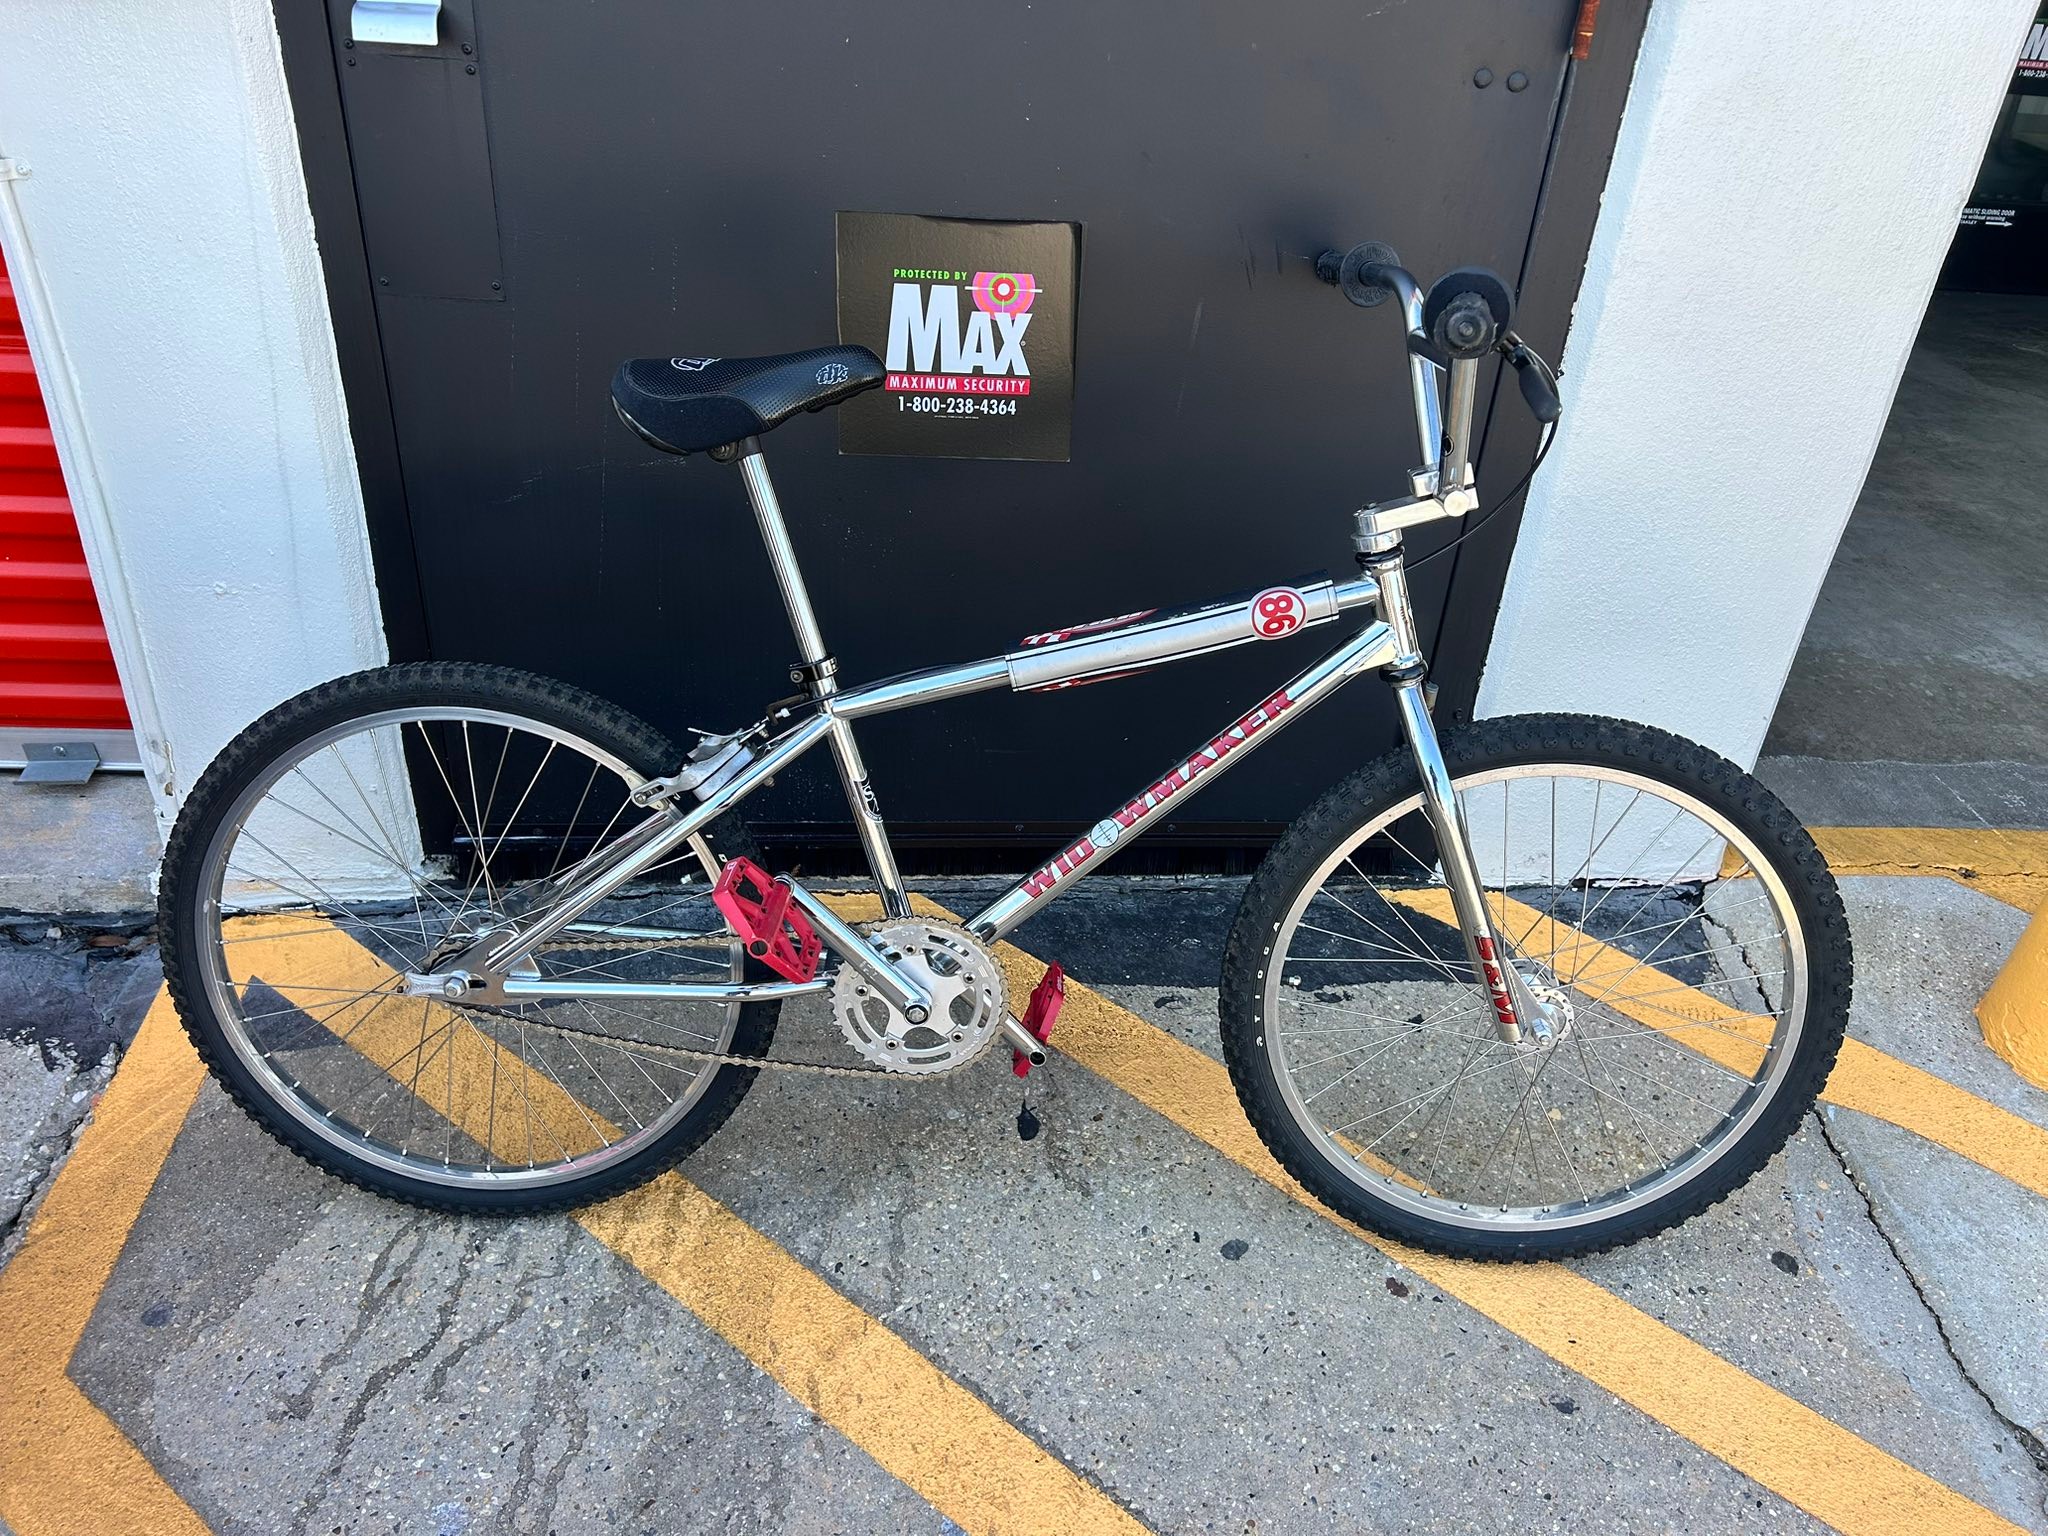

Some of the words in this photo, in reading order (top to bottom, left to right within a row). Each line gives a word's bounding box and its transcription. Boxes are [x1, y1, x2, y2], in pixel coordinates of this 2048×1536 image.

[893, 268, 950, 280] PROTECTED
[954, 270, 967, 281] BY
[886, 282, 1033, 376] MAX
[889, 375, 957, 391] MAXIMUM
[963, 378, 1026, 393] SECURITY
[898, 396, 1017, 416] 1-800-238-4364
[1254, 921, 1281, 1024] TIOGA
[1473, 935, 1520, 1025] S&M
